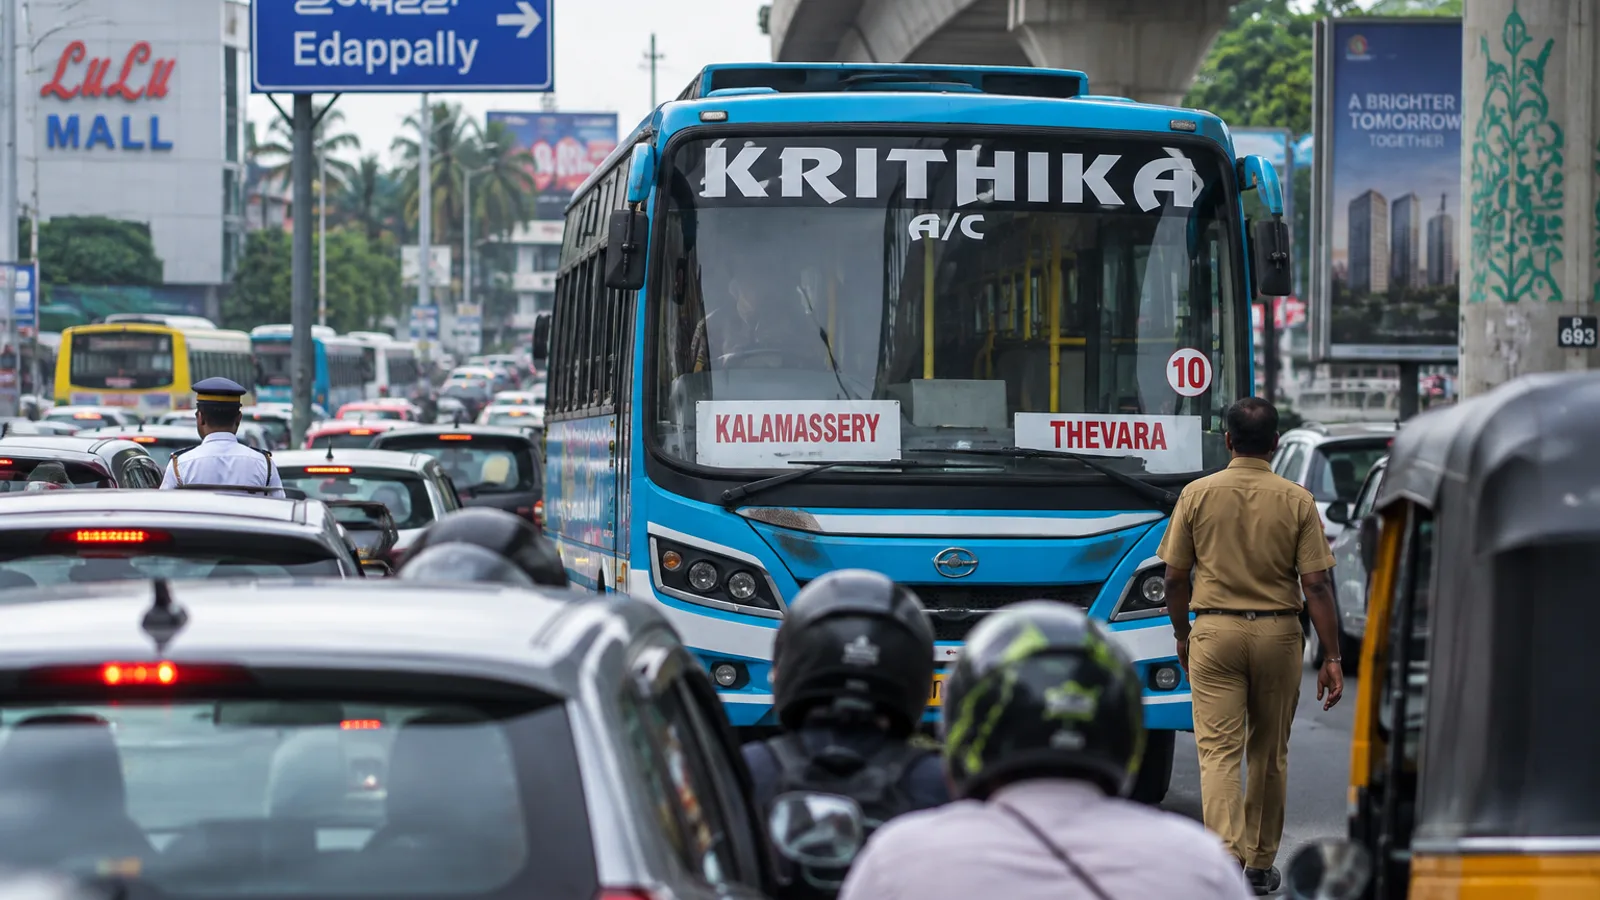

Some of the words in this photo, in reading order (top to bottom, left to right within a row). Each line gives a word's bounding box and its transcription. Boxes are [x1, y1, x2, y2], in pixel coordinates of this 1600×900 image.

[294, 30, 478, 75] Edappally
[1348, 93, 1361, 110] A
[1366, 93, 1455, 110] BRIGHTER
[47, 114, 173, 150] MALL
[1349, 112, 1462, 130] TOMORROW
[1369, 133, 1444, 148] TOGETHER
[700, 141, 1204, 212] KRITHIKA
[909, 212, 985, 241] A/C
[1561, 327, 1595, 345] 693
[1572, 317, 1582, 329] P
[1172, 356, 1205, 389] 10
[715, 413, 880, 443] KALAMASSERY
[1050, 420, 1167, 450] THEVARA
